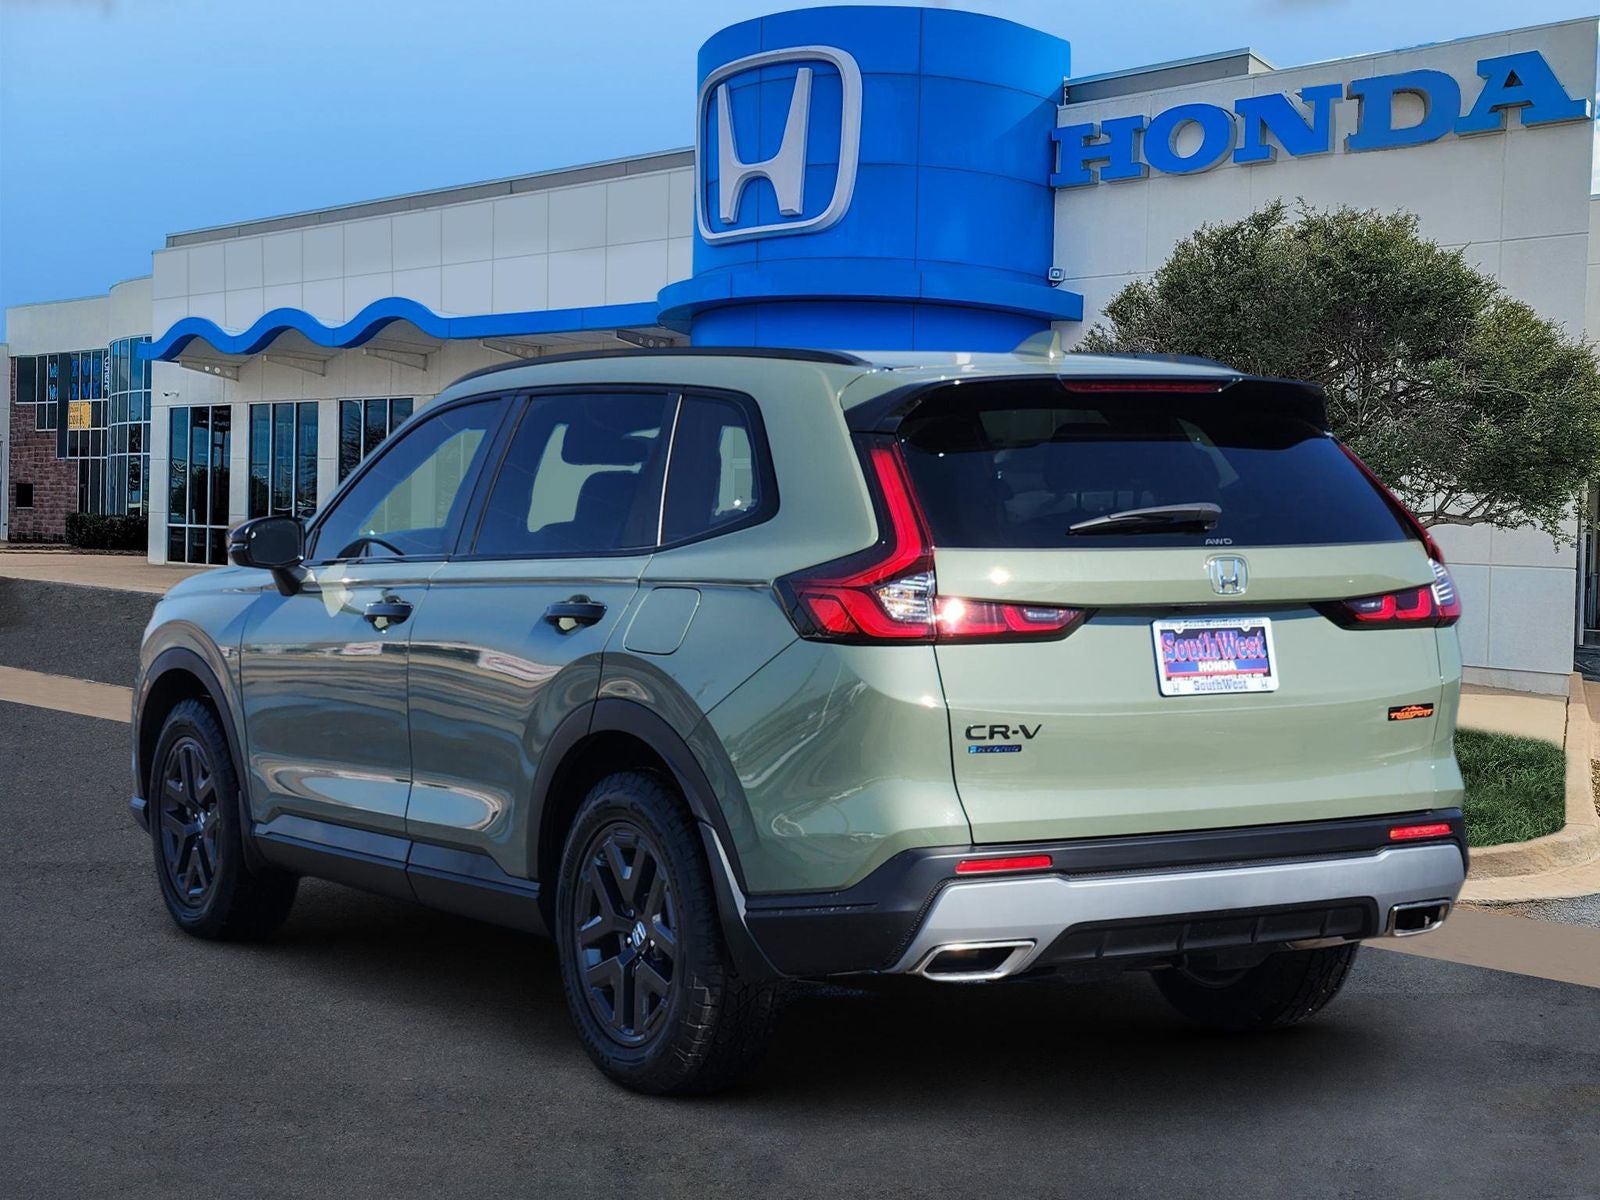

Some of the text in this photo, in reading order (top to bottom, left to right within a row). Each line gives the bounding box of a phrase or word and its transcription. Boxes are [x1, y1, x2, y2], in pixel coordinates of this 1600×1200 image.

[1050, 50, 1591, 189] HONDA
[1204, 537, 1233, 545] AWD
[1161, 629, 1268, 663] SouthWest
[1198, 660, 1237, 673] HONDA
[965, 724, 1042, 740] CR-V
